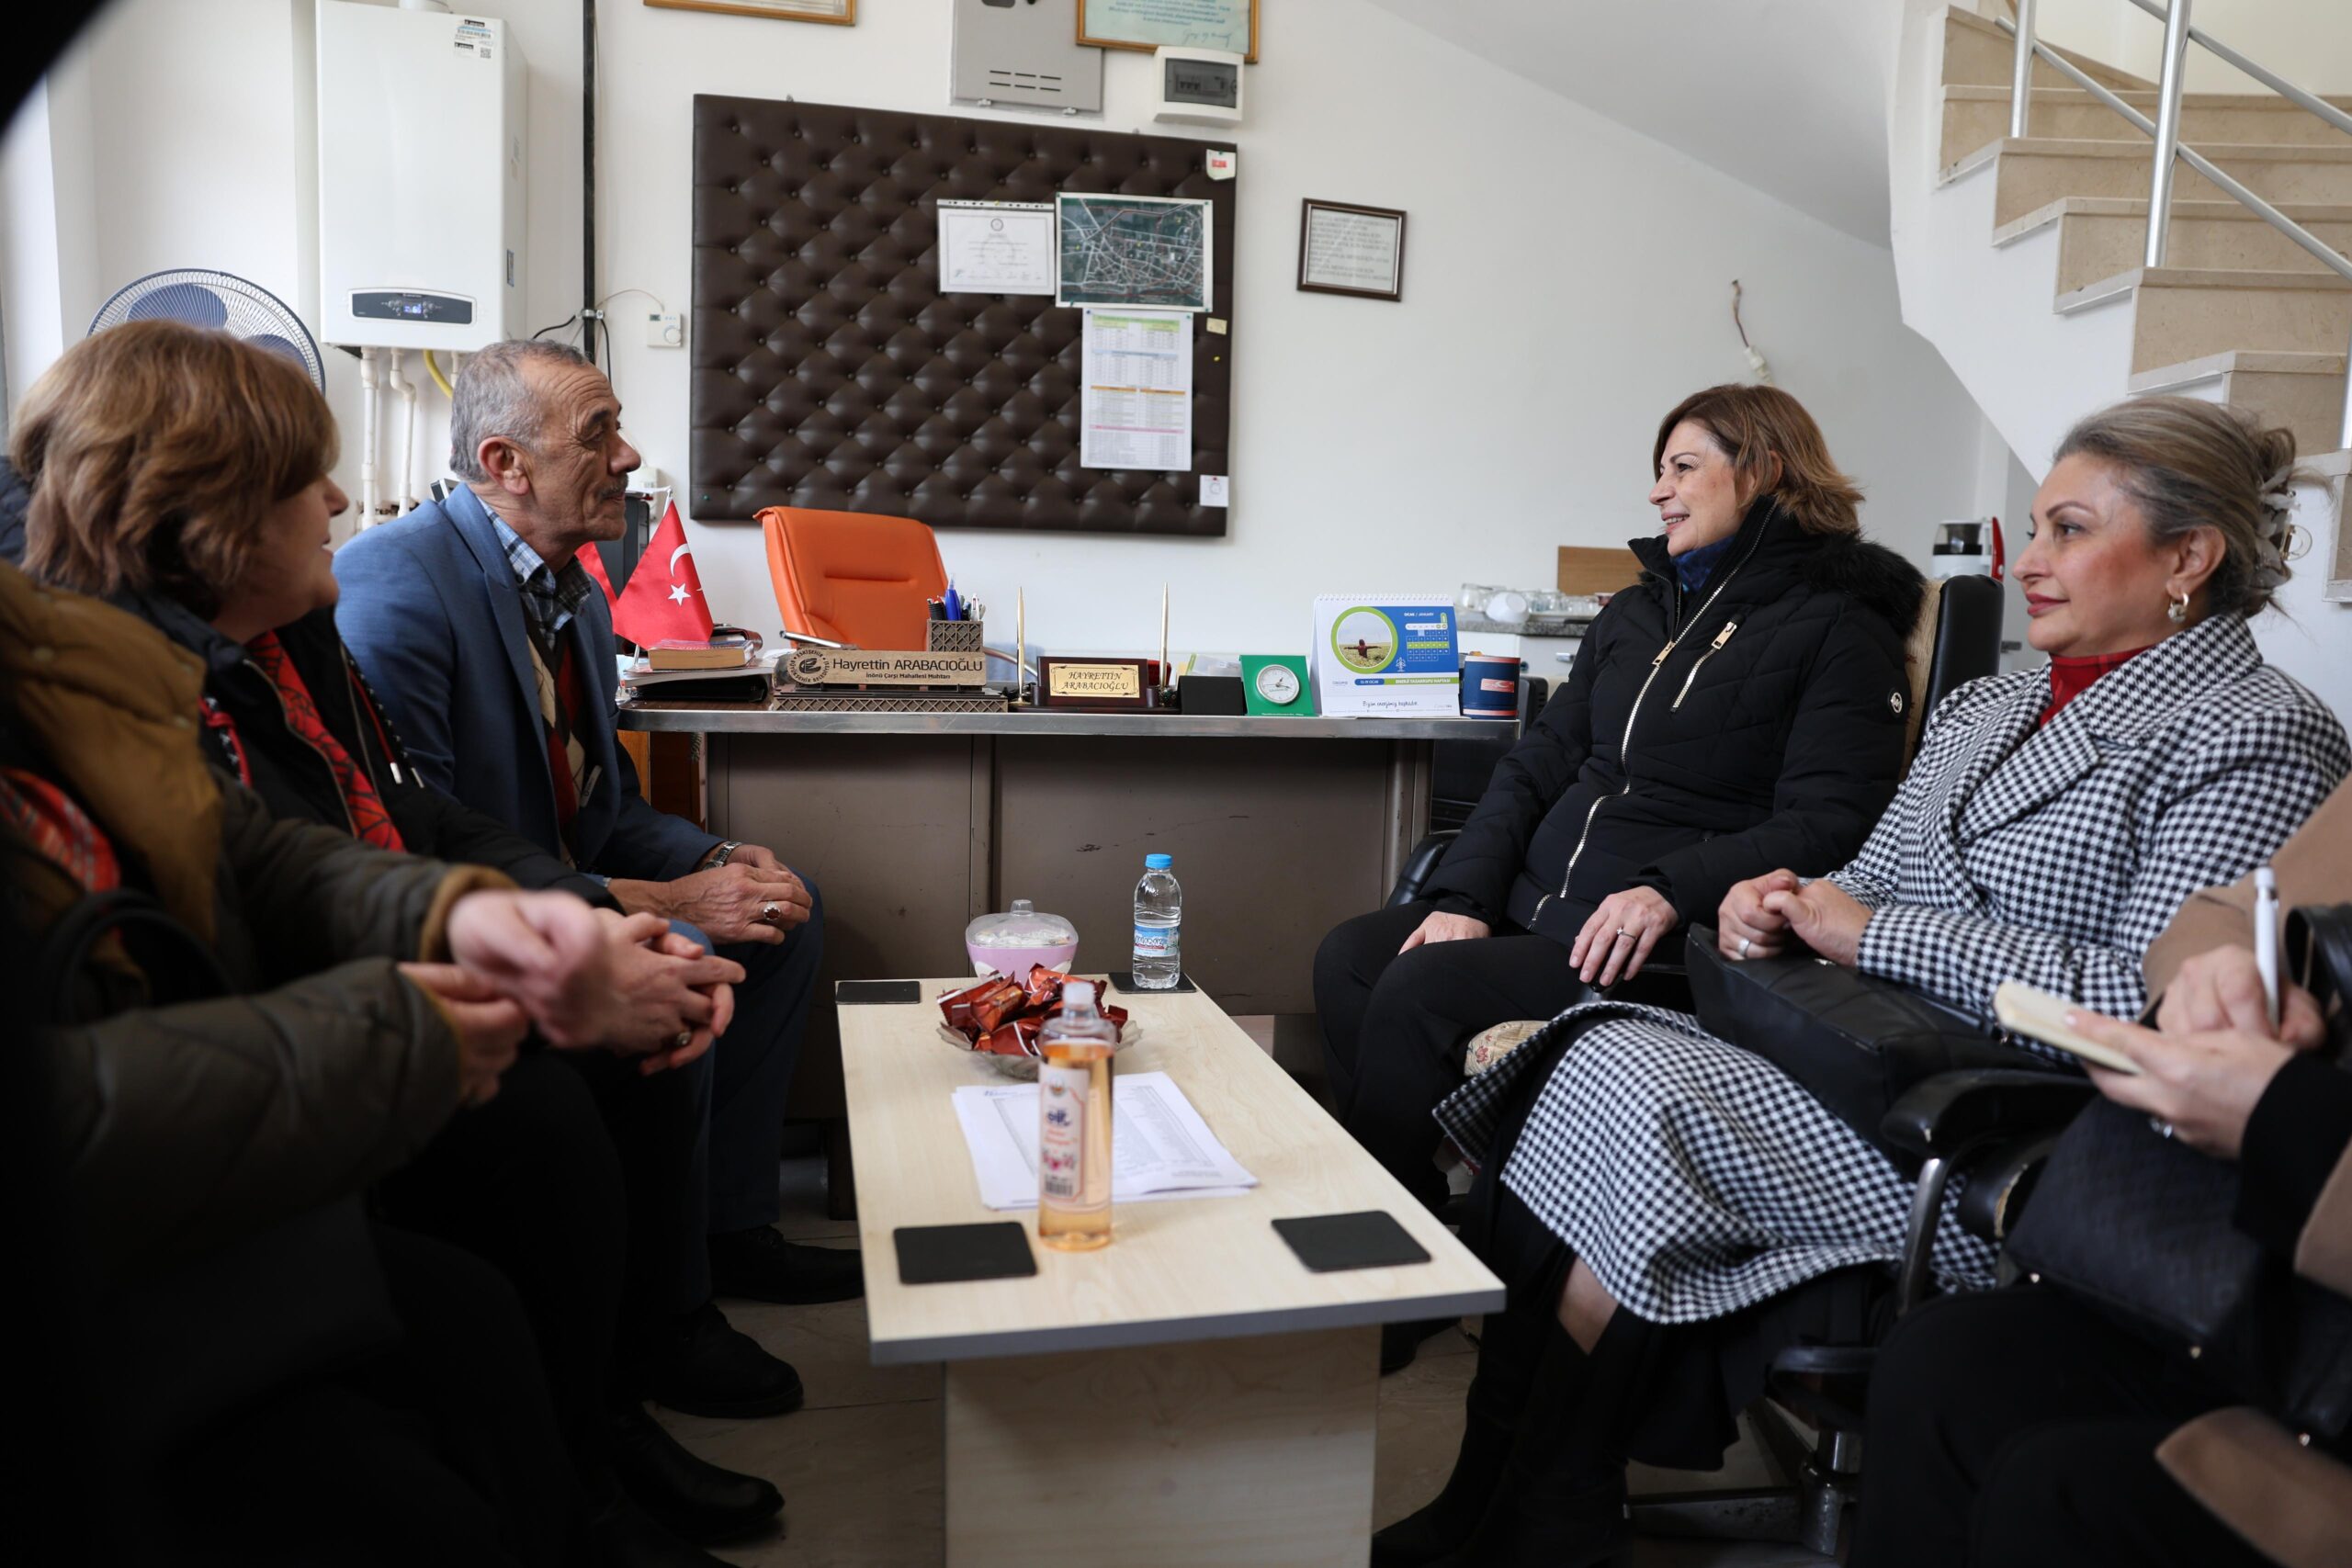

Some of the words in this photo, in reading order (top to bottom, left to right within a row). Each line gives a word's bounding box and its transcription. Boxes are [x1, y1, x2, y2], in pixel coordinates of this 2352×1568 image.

[832, 659, 889, 672] Hayrettin
[894, 658, 982, 671] ARABACIOĞLU
[1069, 671, 1123, 680] HAYRETTİN
[1061, 681, 1129, 692] ARABACIOĞLU
